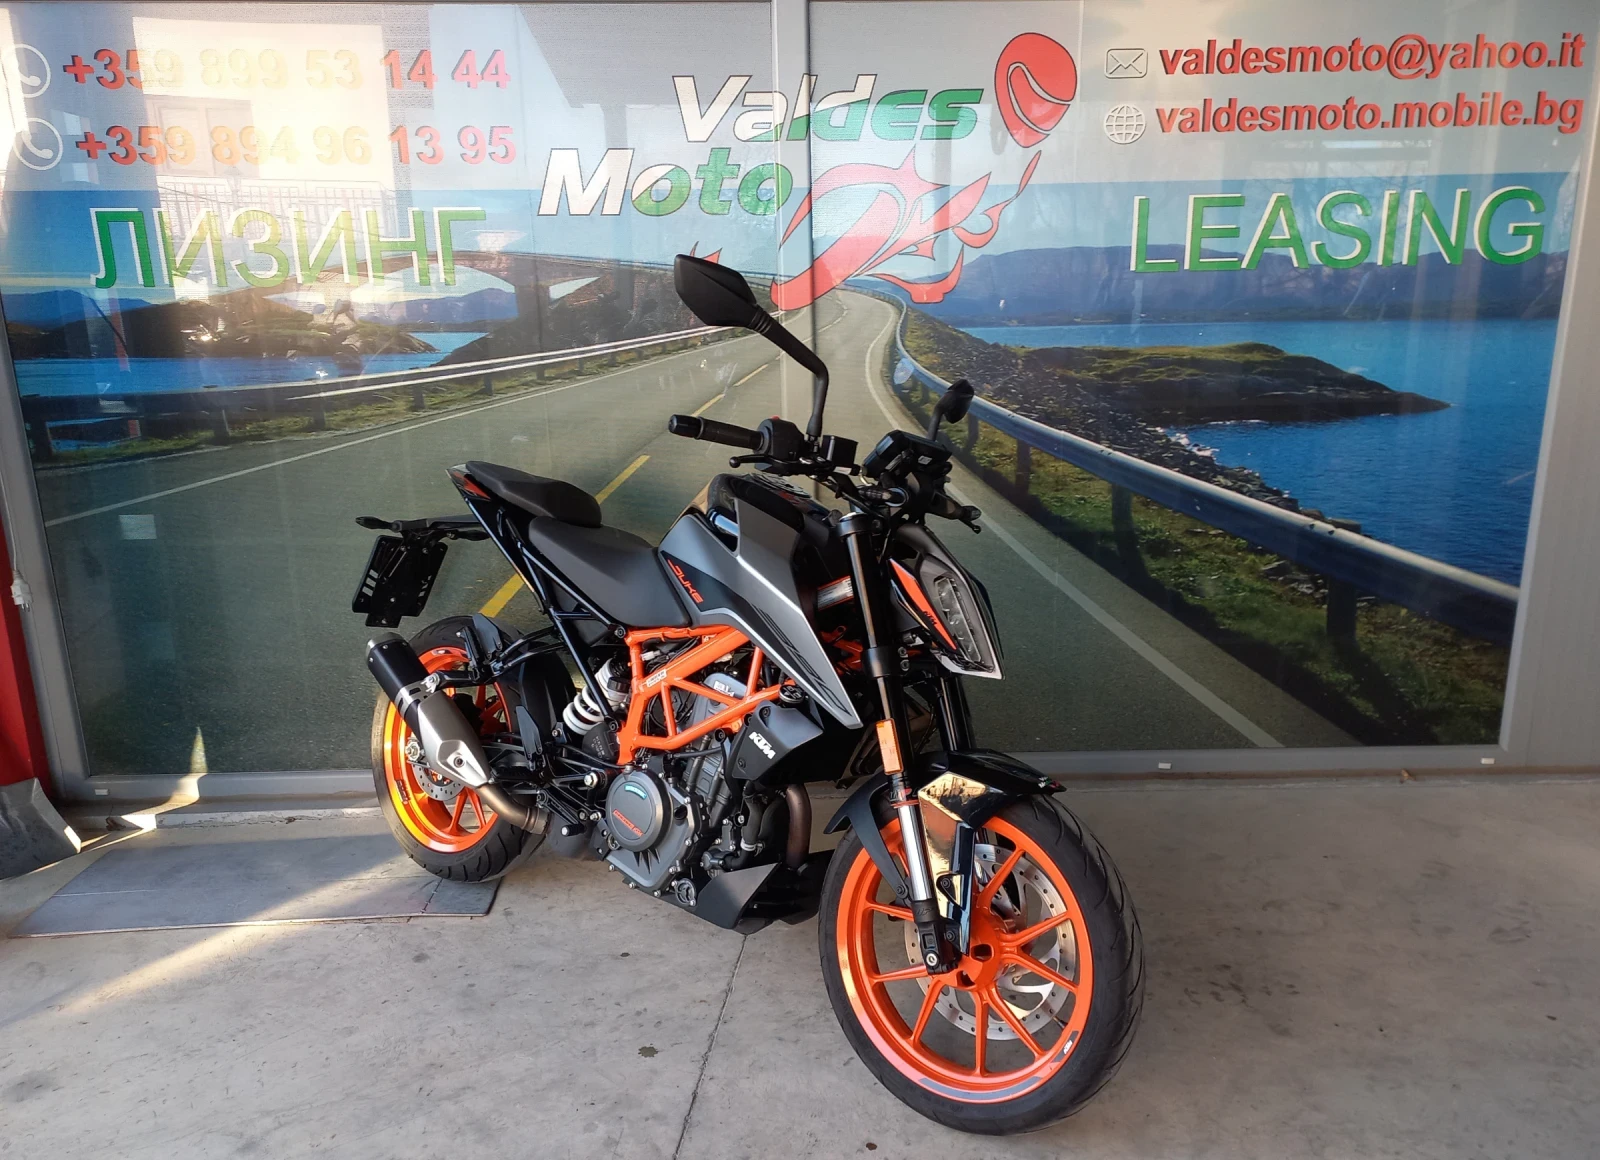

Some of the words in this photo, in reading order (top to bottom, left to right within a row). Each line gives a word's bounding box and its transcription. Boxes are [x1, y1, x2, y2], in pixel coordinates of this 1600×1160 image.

[63, 49, 184, 90] +359
[200, 49, 289, 90] 899
[305, 49, 364, 89] 53
[380, 49, 437, 89] 14
[452, 49, 511, 88] 44
[1159, 33, 1585, 80] valdesmoto@yahoo.it
[672, 73, 984, 143] Valdes
[1155, 91, 1585, 135] valdesmoto.mobile.bg
[75, 125, 196, 166] +359
[211, 126, 298, 165] 894
[315, 126, 373, 165] 96
[388, 126, 445, 165] 13
[459, 125, 517, 165] 95
[537, 147, 793, 217] Moto
[90, 206, 487, 289] ЛИЗИНГ
[1129, 185, 1546, 273] LEASING
[748, 731, 777, 760] KTM
